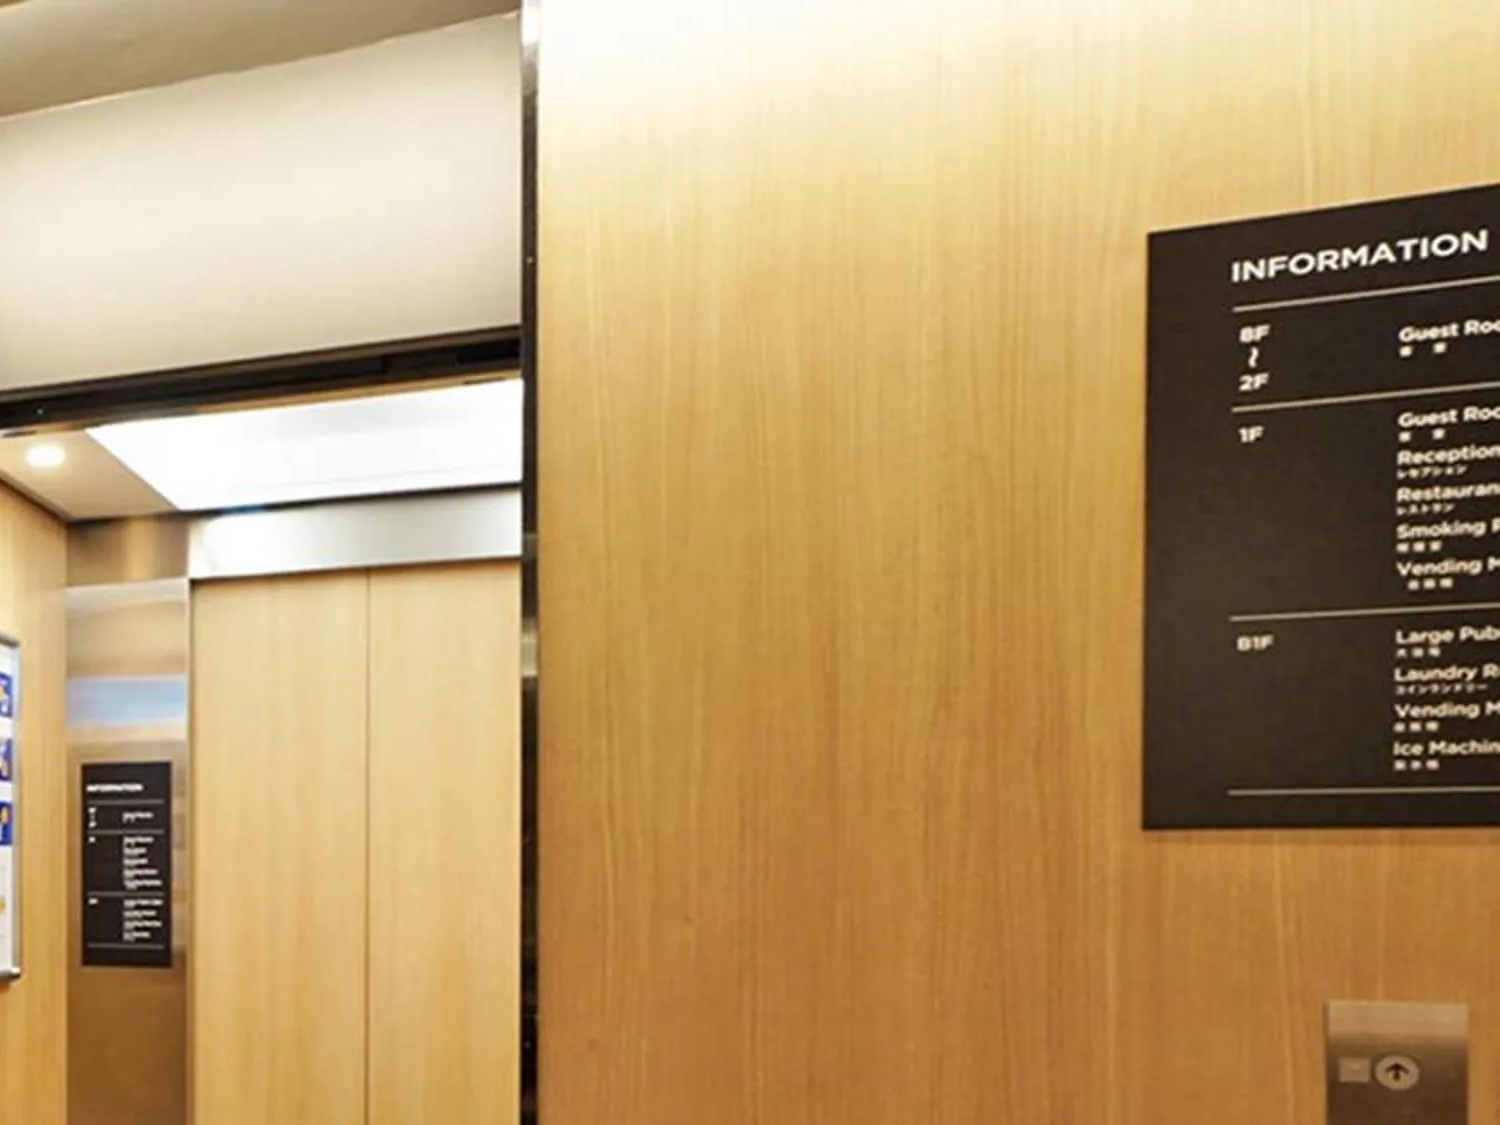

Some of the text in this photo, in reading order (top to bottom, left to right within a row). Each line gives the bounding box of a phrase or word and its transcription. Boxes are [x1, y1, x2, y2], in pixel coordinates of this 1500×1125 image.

[1231, 229, 1489, 283] INFORMATION
[1240, 324, 1271, 343] 8F
[1398, 322, 1459, 342] Guest
[1239, 372, 1269, 391] 2F
[1398, 409, 1458, 428] Guest
[1238, 425, 1264, 443] 1F
[1396, 520, 1487, 539] Smoking
[1396, 557, 1483, 577] Vending
[1236, 634, 1274, 652] B1F
[1395, 629, 1455, 645] Large
[1394, 665, 1479, 682] Laundry
[1394, 701, 1481, 719] Vending
[1393, 741, 1425, 756] Ice
